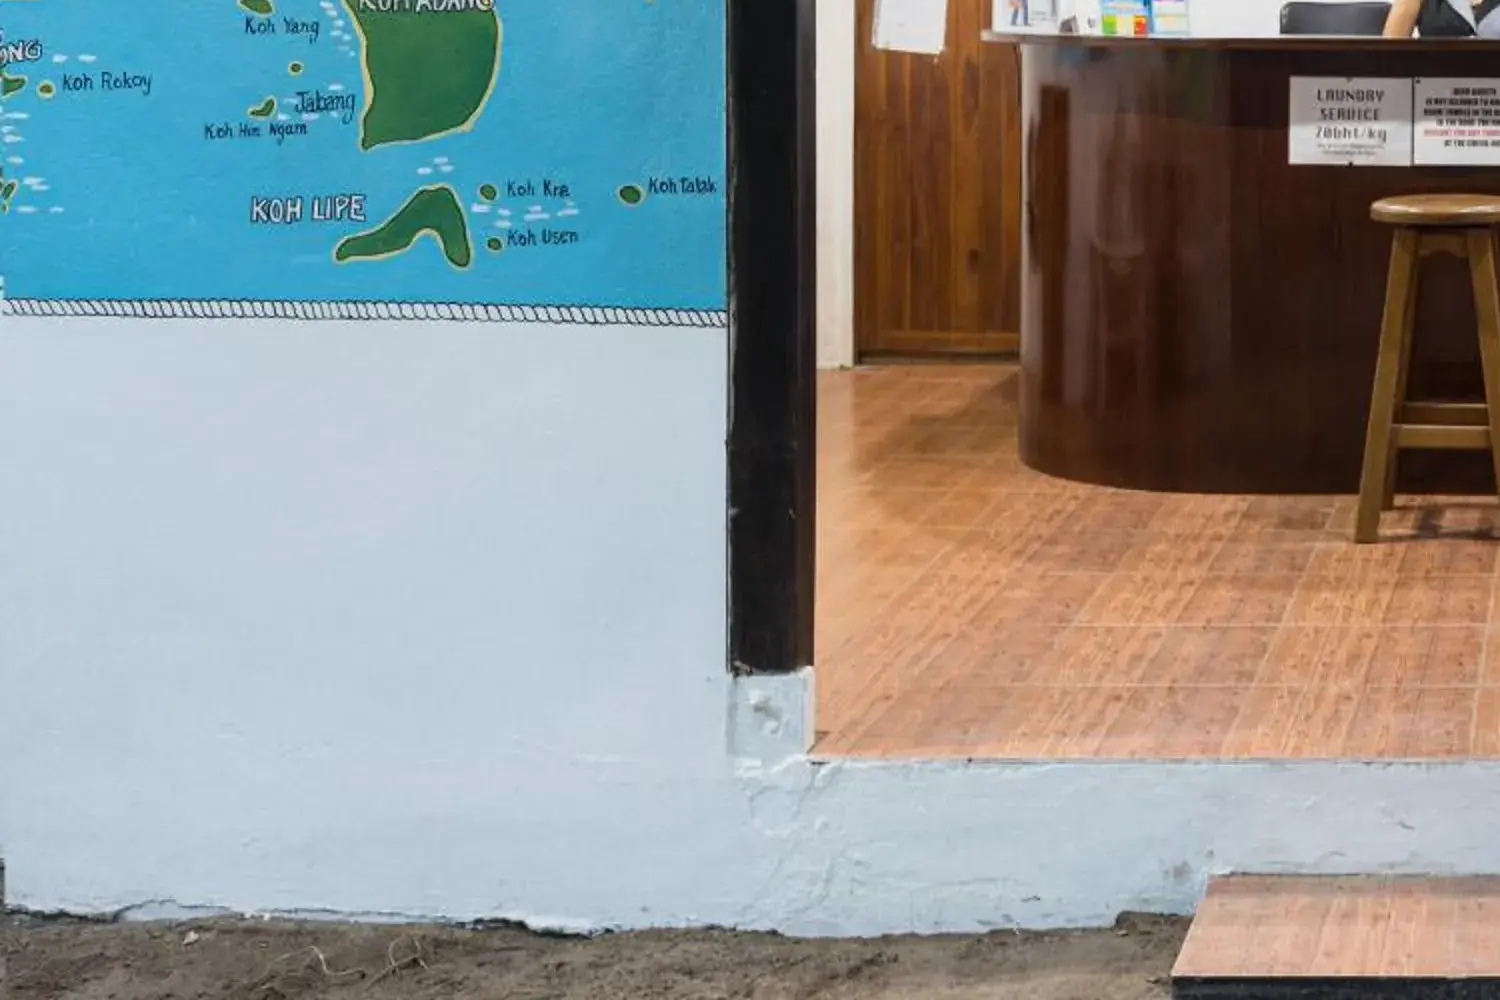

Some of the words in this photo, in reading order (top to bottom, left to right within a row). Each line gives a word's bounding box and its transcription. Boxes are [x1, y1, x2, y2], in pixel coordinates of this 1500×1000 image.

[245, 15, 275, 36] Koh
[62, 72, 94, 92] Koh
[1316, 88, 1384, 102] LAUNDRY
[1320, 107, 1381, 121] SERVICE
[250, 196, 304, 224] KOH
[311, 195, 367, 223] LIPE
